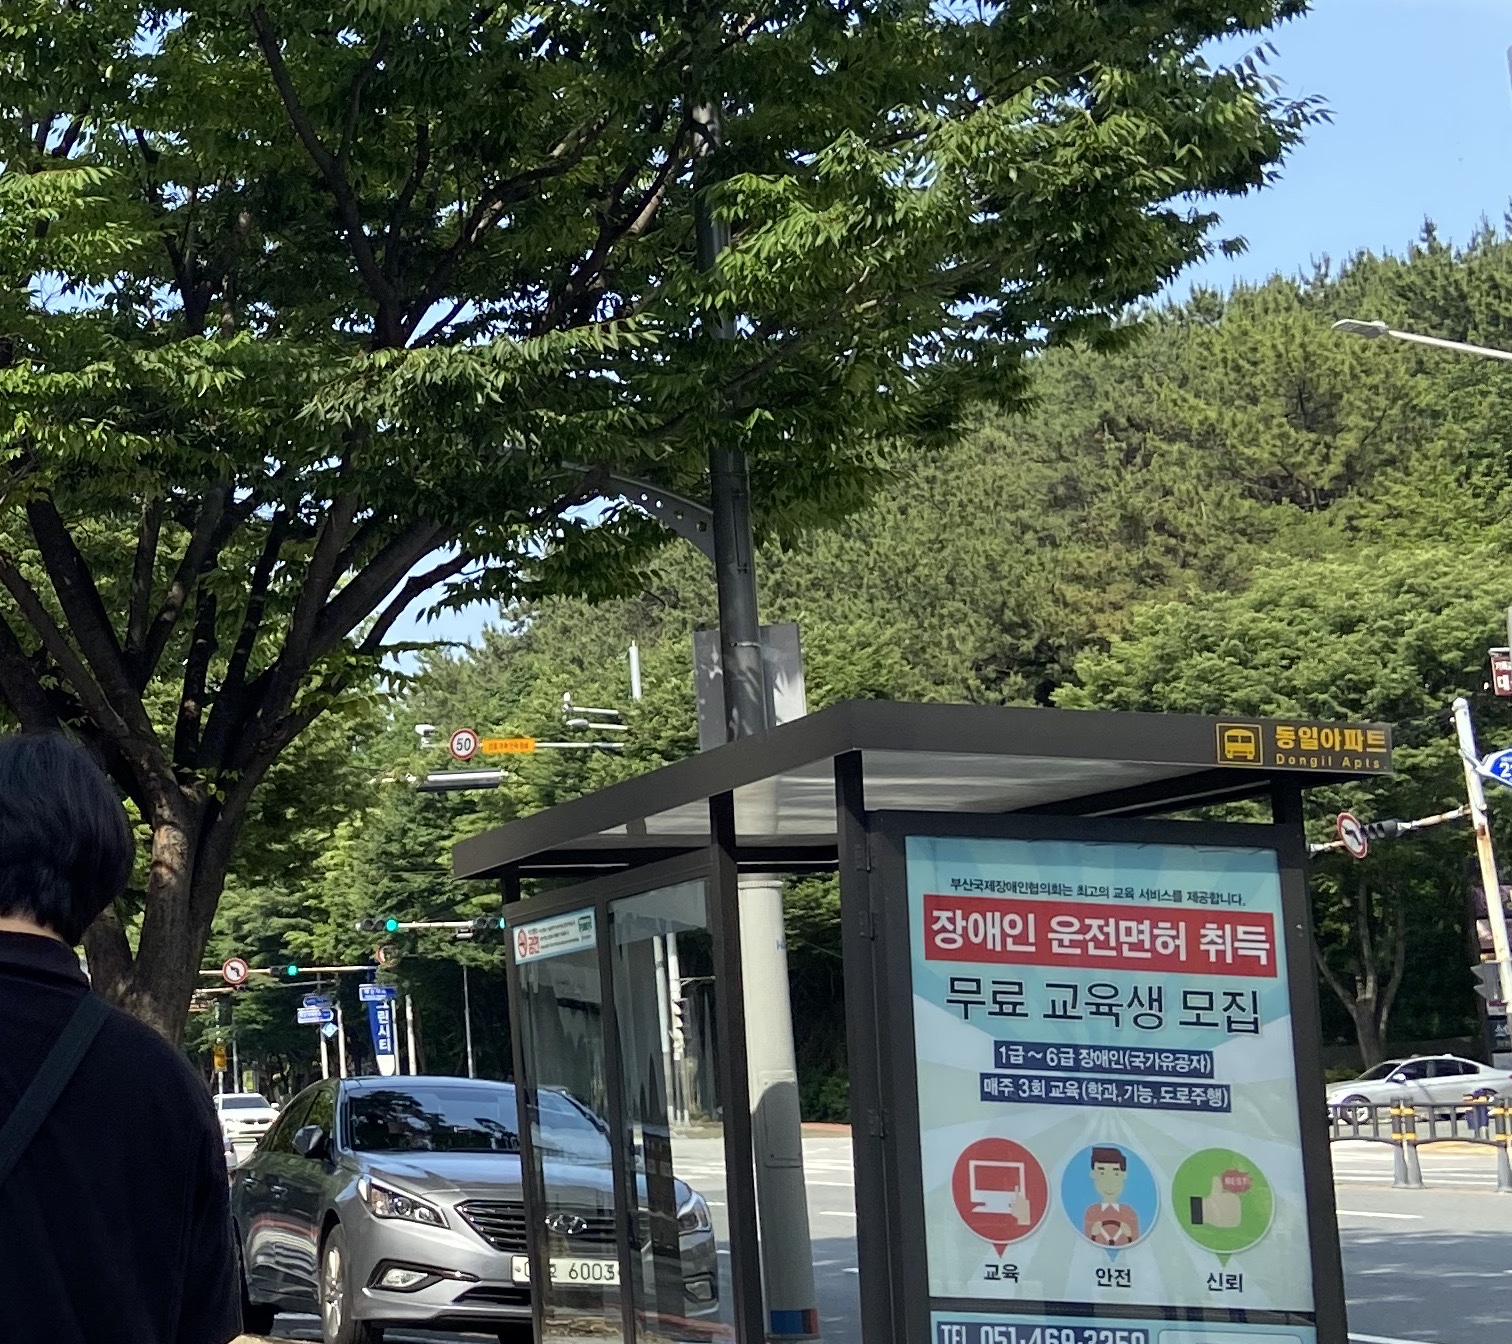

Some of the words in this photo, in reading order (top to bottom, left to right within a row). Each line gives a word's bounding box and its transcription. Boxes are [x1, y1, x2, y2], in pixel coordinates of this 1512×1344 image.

[456, 738, 471, 751] 50
[1275, 725, 1387, 752] 동일아파트
[1276, 753, 1332, 767] Dongil
[951, 877, 1073, 896] 부산국제장애인협의회는
[1077, 885, 1109, 899] 최고의
[1113, 887, 1134, 900] 교육
[1139, 888, 1182, 903] 서비스를
[931, 908, 1036, 953] 장애인
[1047, 914, 1187, 961] 운전면허
[1199, 922, 1271, 965] 취득
[946, 976, 1029, 1020] 무료
[1042, 982, 1163, 1030] 교육생
[1178, 990, 1261, 1035] 모집
[999, 1045, 1024, 1064] 1급
[1046, 1048, 1074, 1067] 6급
[1079, 1049, 1211, 1074] 장애인(국가유공자)
[983, 1077, 1015, 1097] 매주
[1018, 1080, 1045, 1098] 3회
[569, 1263, 614, 1280] 6003
[983, 1263, 1020, 1283] 교육
[1095, 1267, 1132, 1288] 안전
[1206, 1273, 1243, 1293] 신뢰
